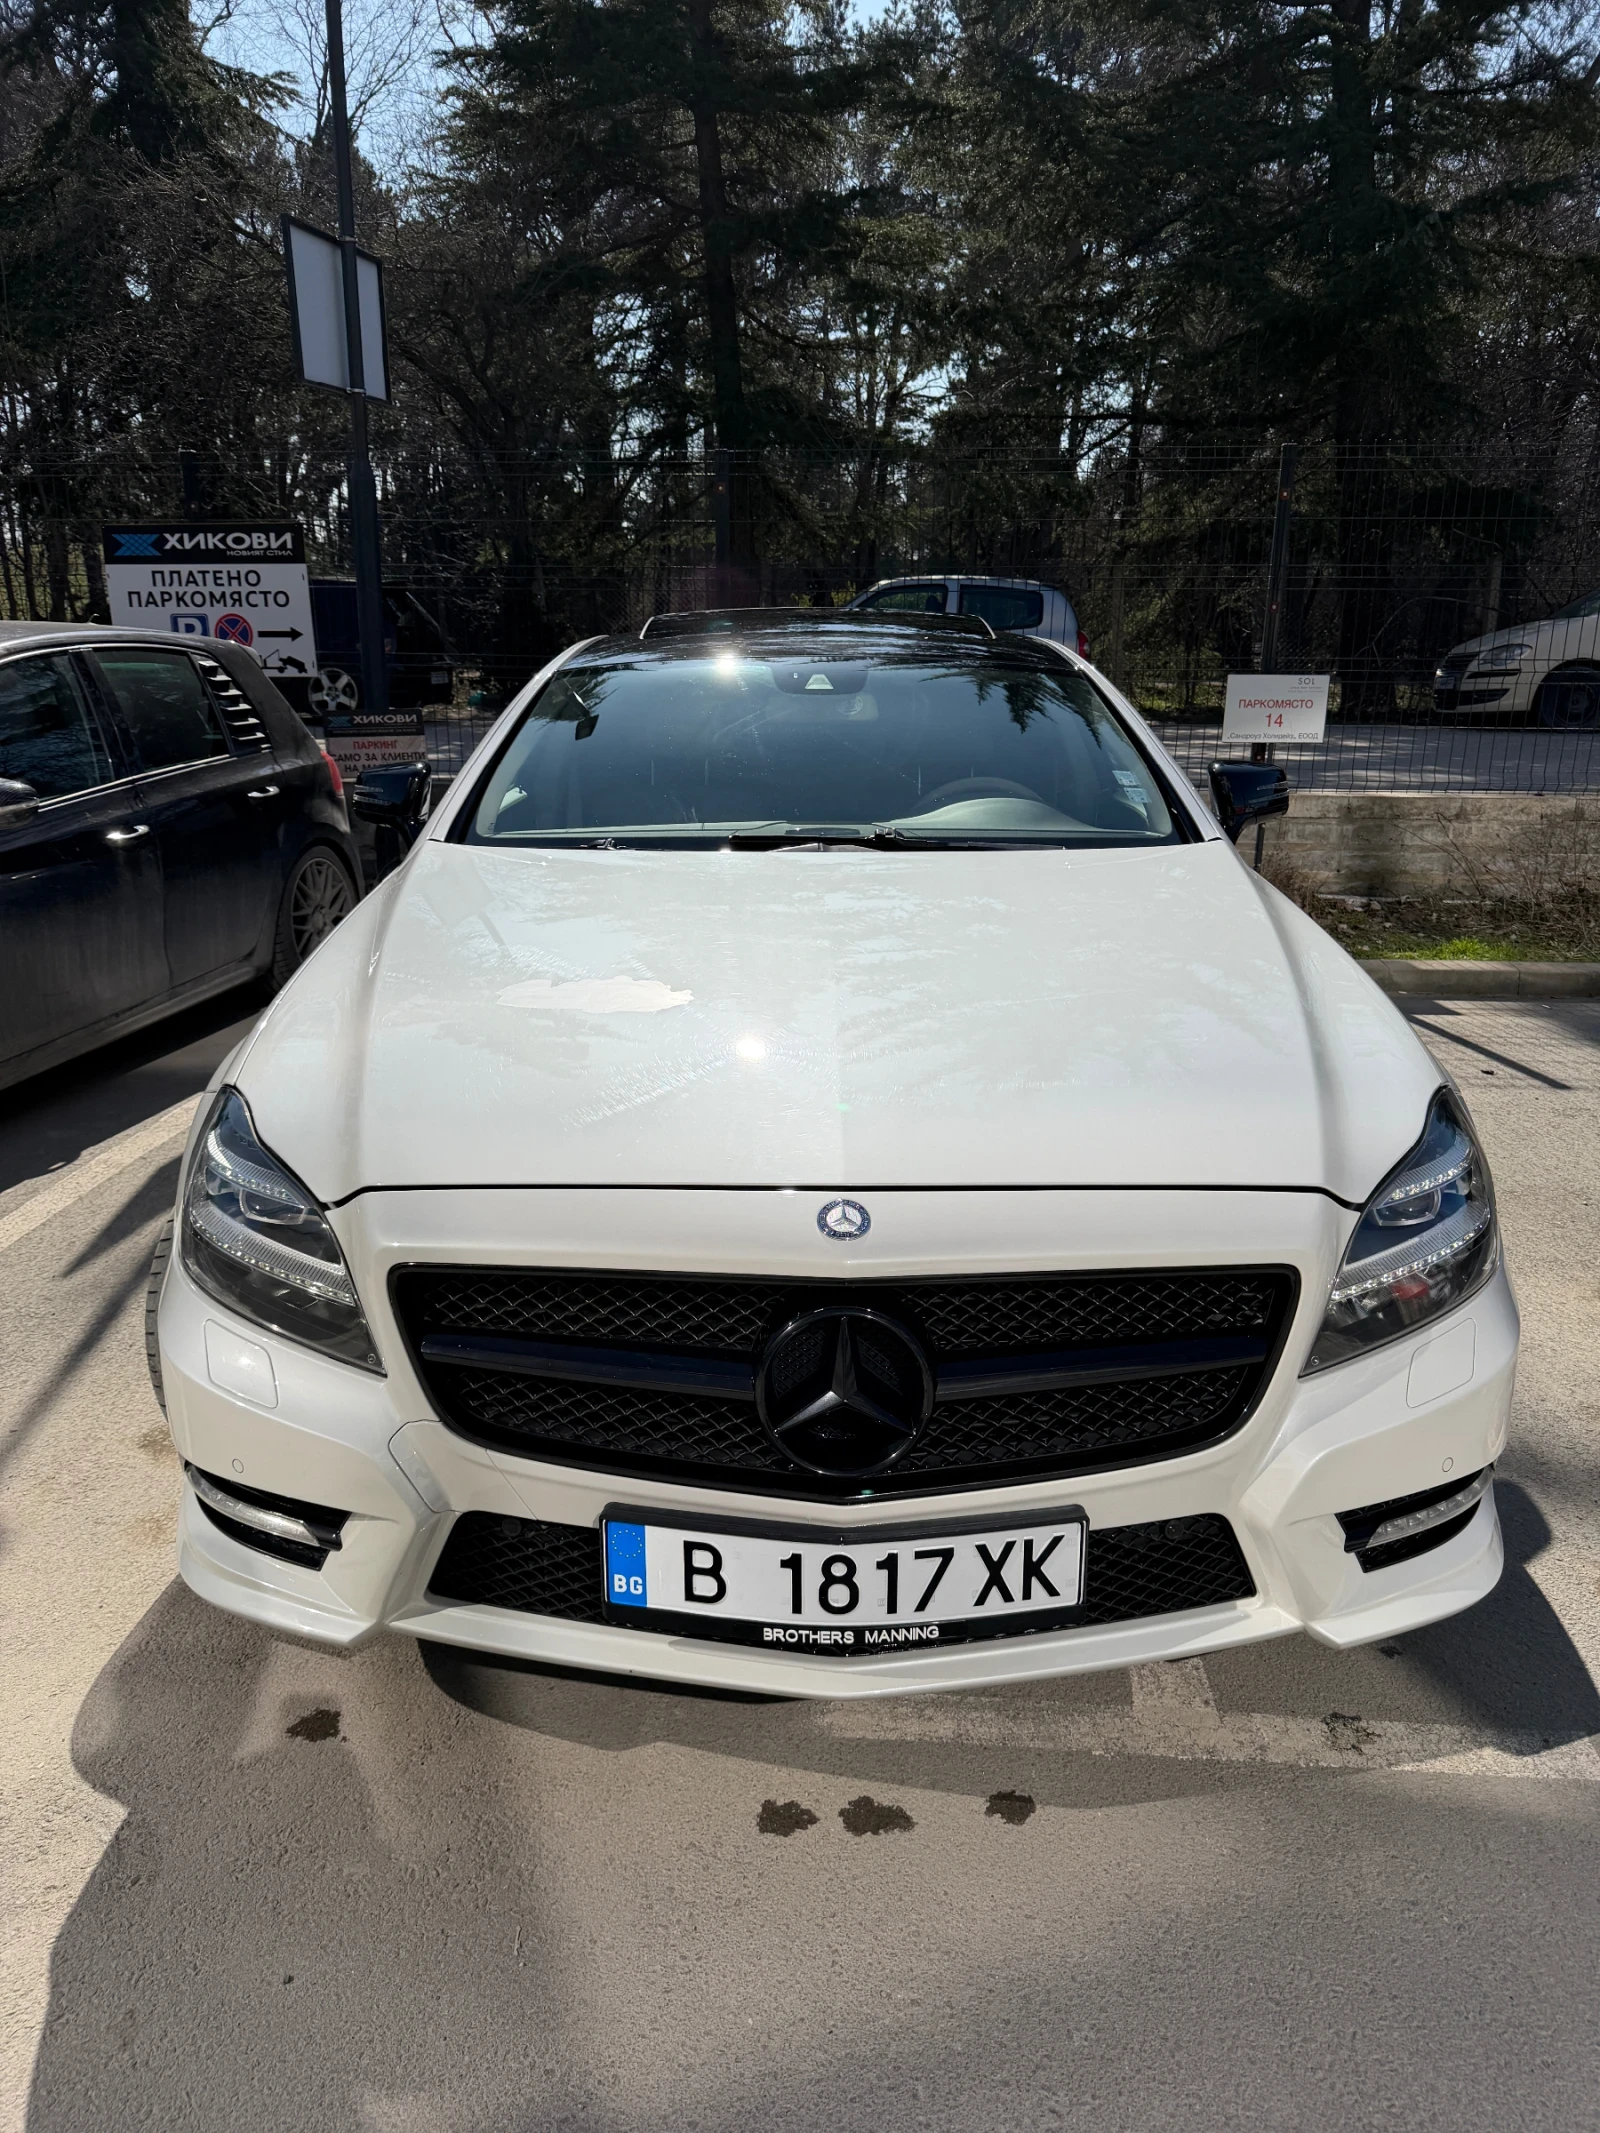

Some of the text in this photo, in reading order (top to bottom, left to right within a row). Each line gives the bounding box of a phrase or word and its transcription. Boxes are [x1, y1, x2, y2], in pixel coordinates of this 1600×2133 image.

[163, 532, 293, 550] ХИКОВИ
[151, 570, 261, 587] ПЛАТЕНО
[128, 591, 290, 608] ПАРКОМЯСТО
[1238, 699, 1314, 709] ПАРКОМЯСТО
[353, 714, 418, 724] ХИКОВИ
[1265, 713, 1284, 728] 14
[1298, 732, 1319, 740] ЕООД
[353, 740, 398, 750] ПАРКИНГ
[330, 752, 426, 762] САМО ЗА КЛИЕНТИ
[345, 764, 359, 773] НА
[683, 1534, 1066, 1615] B 1817 XK
[613, 1574, 644, 1595] BG
[763, 1625, 940, 1645] BROTHERS MANNING
